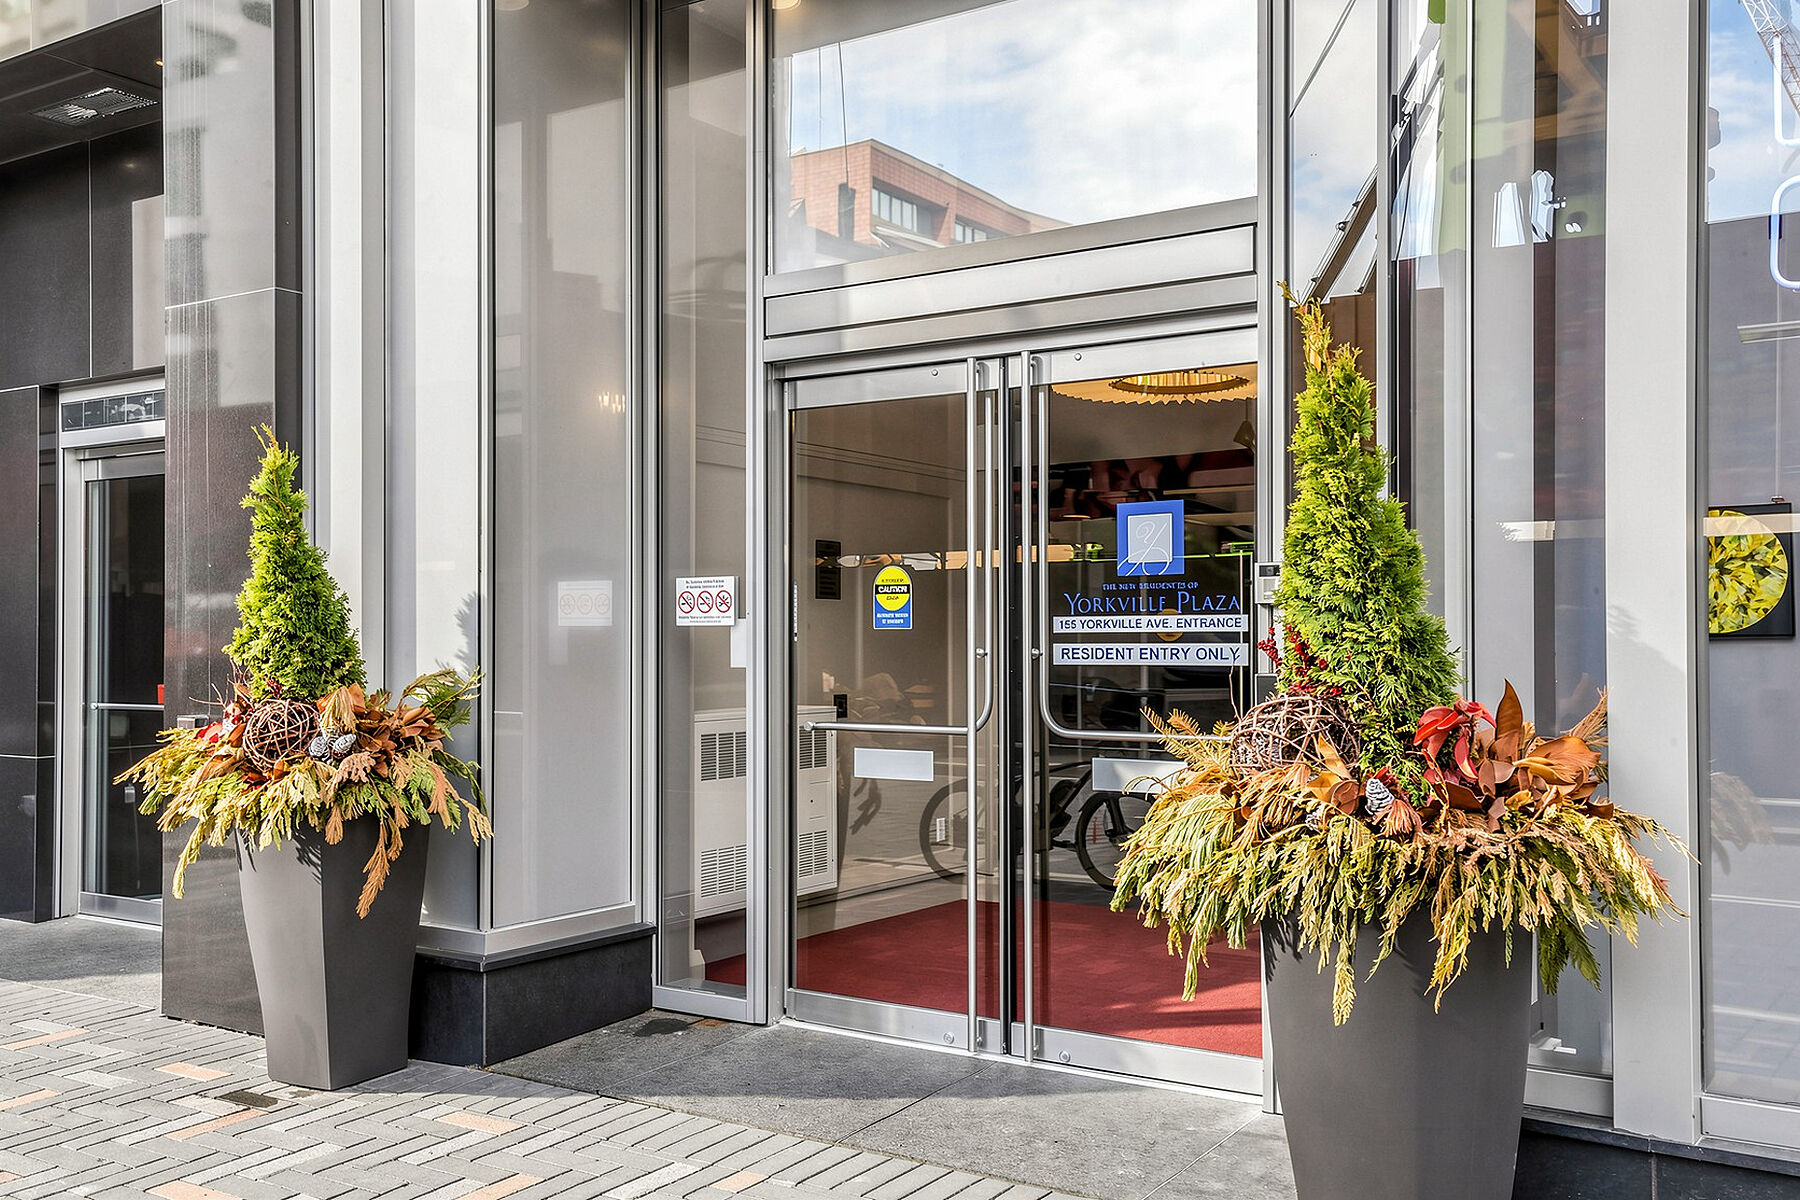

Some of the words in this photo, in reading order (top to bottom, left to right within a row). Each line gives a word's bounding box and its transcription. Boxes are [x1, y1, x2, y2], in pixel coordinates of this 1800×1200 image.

[1063, 591, 1168, 615] YORKVILLE
[1177, 590, 1240, 614] PLAZA
[1059, 619, 1077, 630] 155
[1079, 618, 1143, 630] YORKVILLE
[1145, 618, 1173, 629] AVE.
[1176, 617, 1242, 629] ENTRANCE
[1060, 647, 1134, 660] RESIDENT
[1139, 647, 1191, 660] ENTRY
[1195, 647, 1241, 661] ONLY
